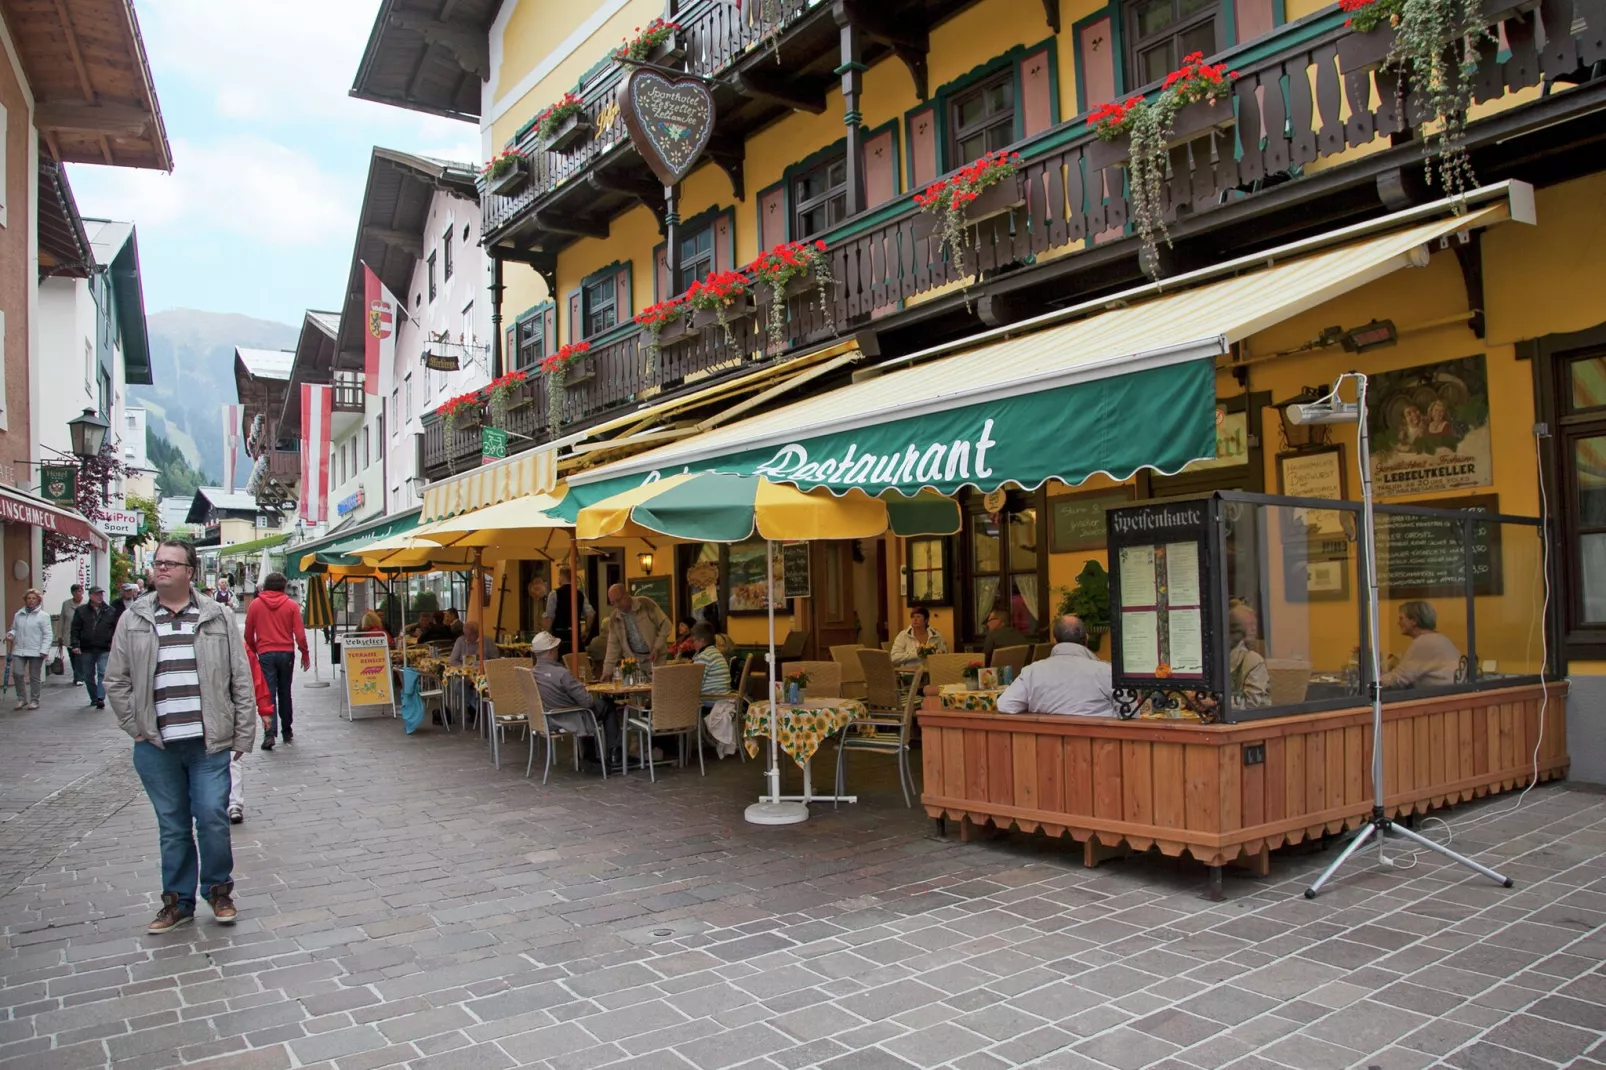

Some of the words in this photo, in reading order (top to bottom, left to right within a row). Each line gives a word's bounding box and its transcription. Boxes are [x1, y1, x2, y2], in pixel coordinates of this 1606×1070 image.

[648, 86, 699, 105] Sporthotel
[651, 96, 696, 115] Lebzelter
[756, 418, 996, 485] Restaurant
[1384, 463, 1476, 483] LEBZELTKELLER
[1417, 478, 1429, 487] 20
[104, 523, 129, 532] Sport
